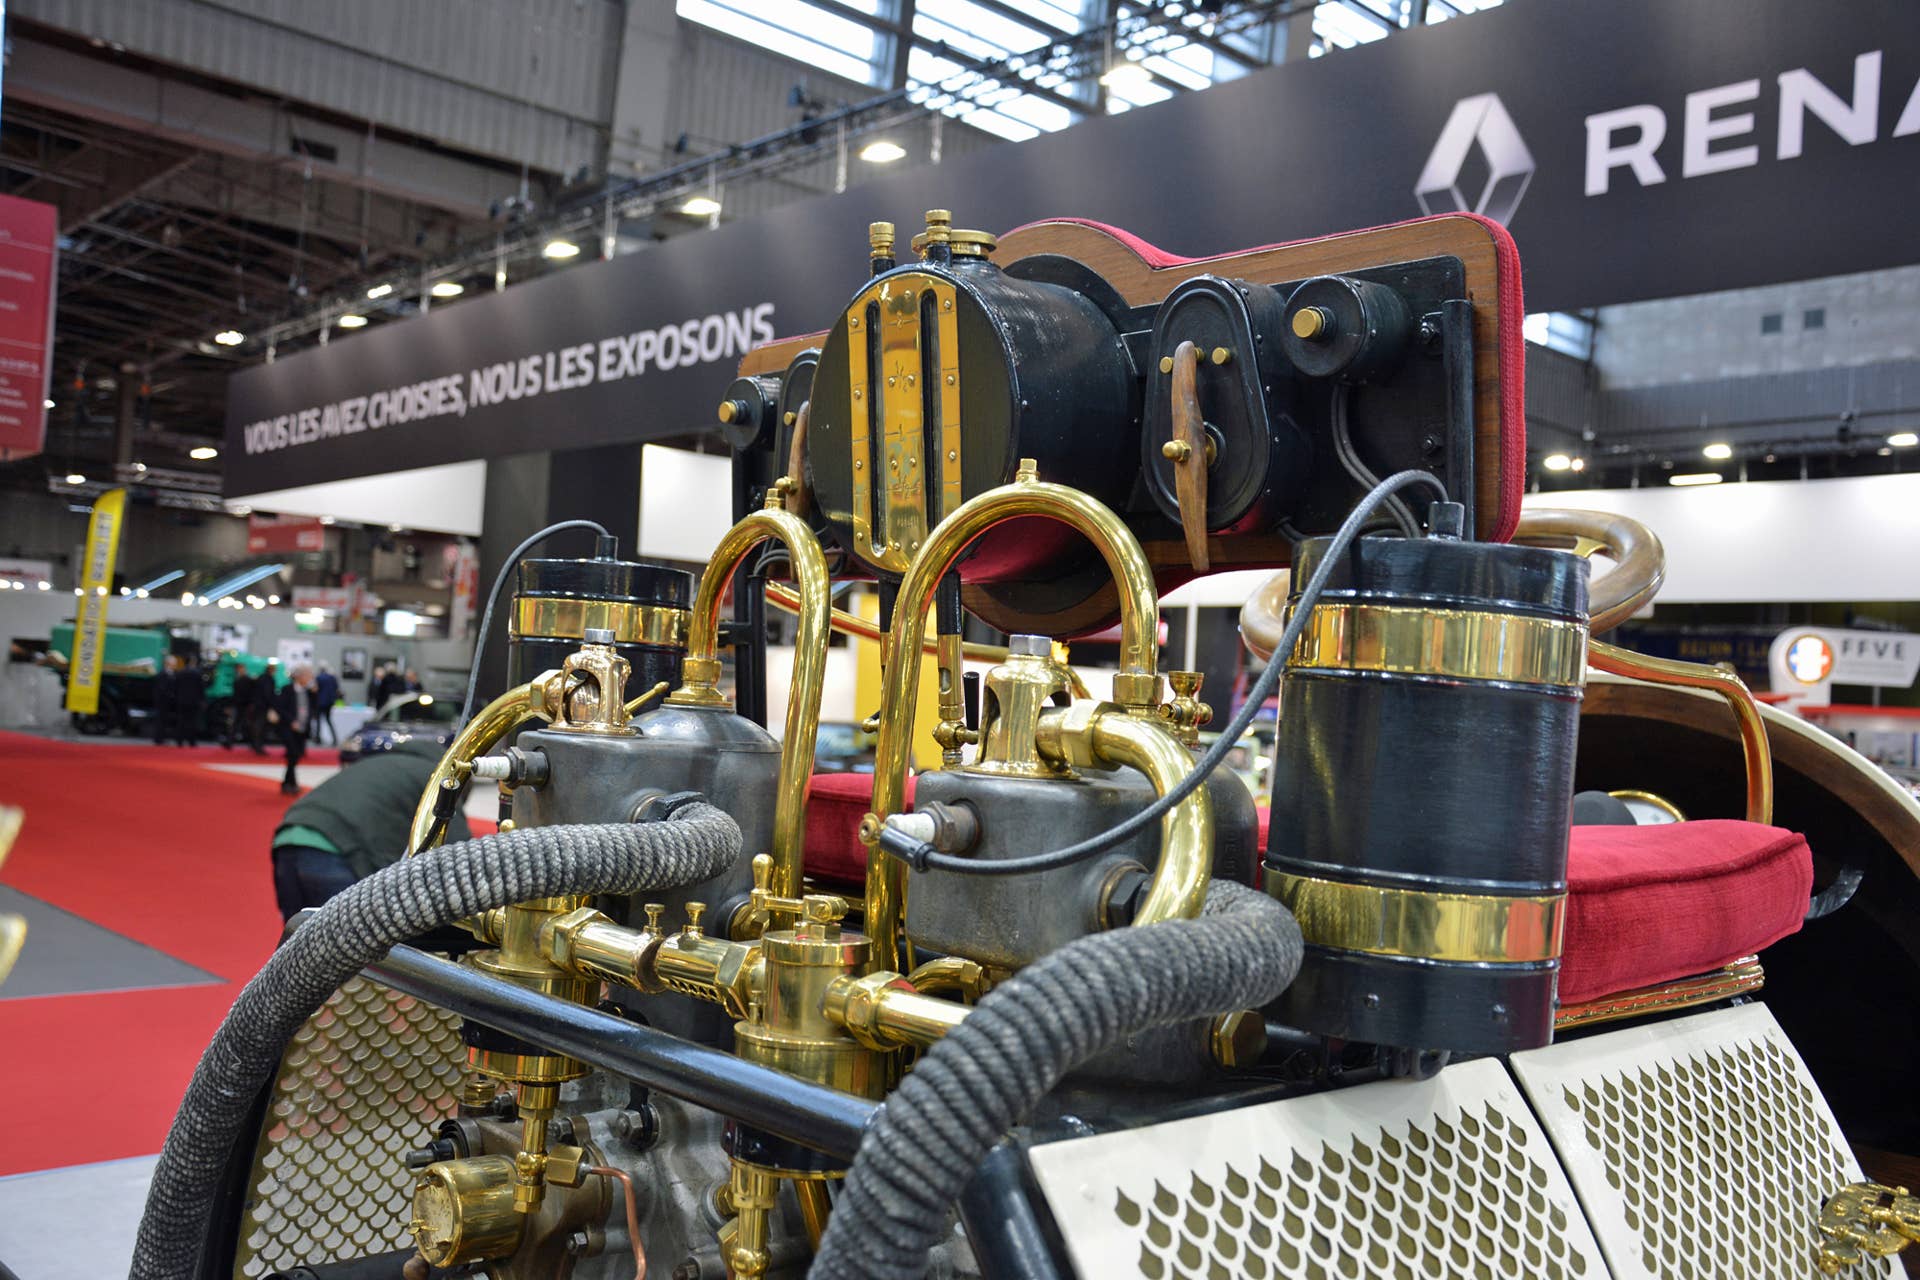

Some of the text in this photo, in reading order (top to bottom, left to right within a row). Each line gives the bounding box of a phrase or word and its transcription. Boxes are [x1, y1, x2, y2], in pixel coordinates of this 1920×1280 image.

[244, 302, 775, 455] VOUS LES AVEZ CHOISIES, NOUS LES EXPOSONS
[1842, 637, 1906, 661] FFVE
